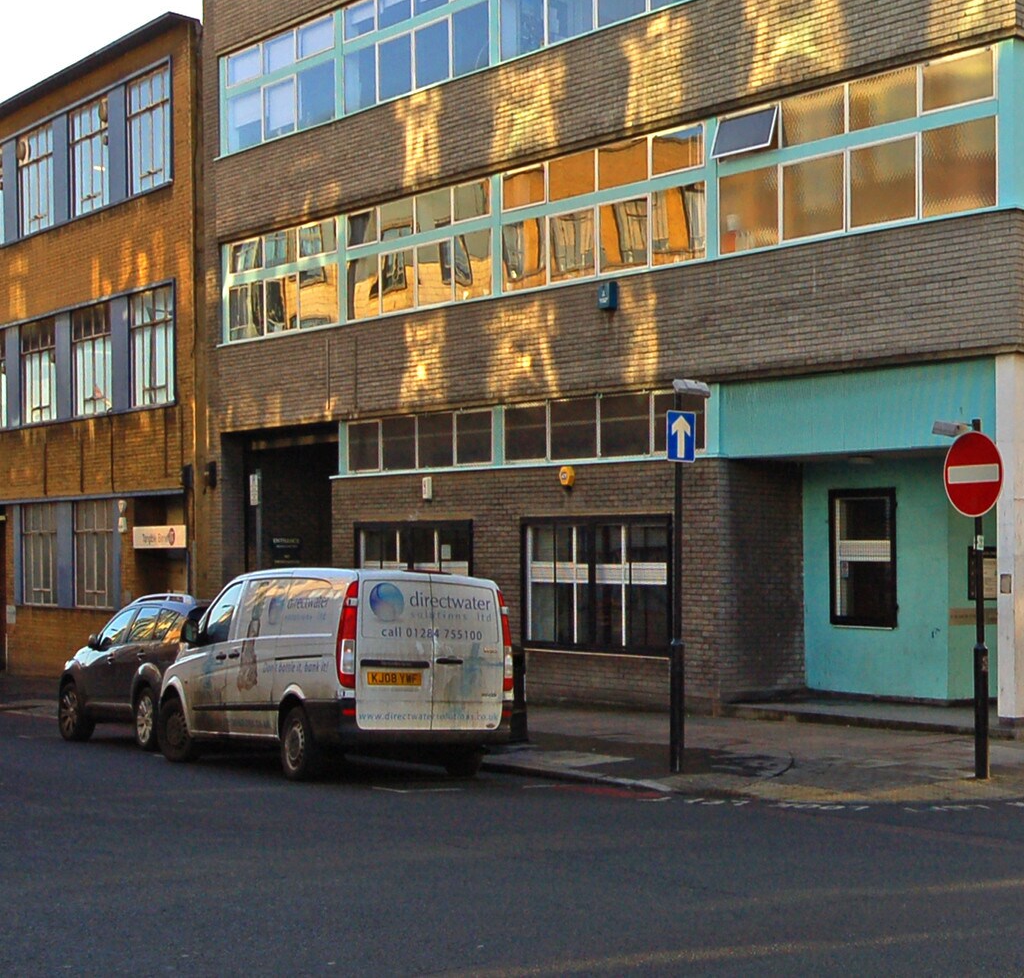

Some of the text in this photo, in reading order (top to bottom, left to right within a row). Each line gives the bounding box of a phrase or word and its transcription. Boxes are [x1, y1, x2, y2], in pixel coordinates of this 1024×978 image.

[410, 590, 491, 610] directwater
[410, 608, 492, 622] solutions ltd
[381, 626, 483, 641] call 01284 755100
[371, 673, 418, 685] KJ08 YWF
